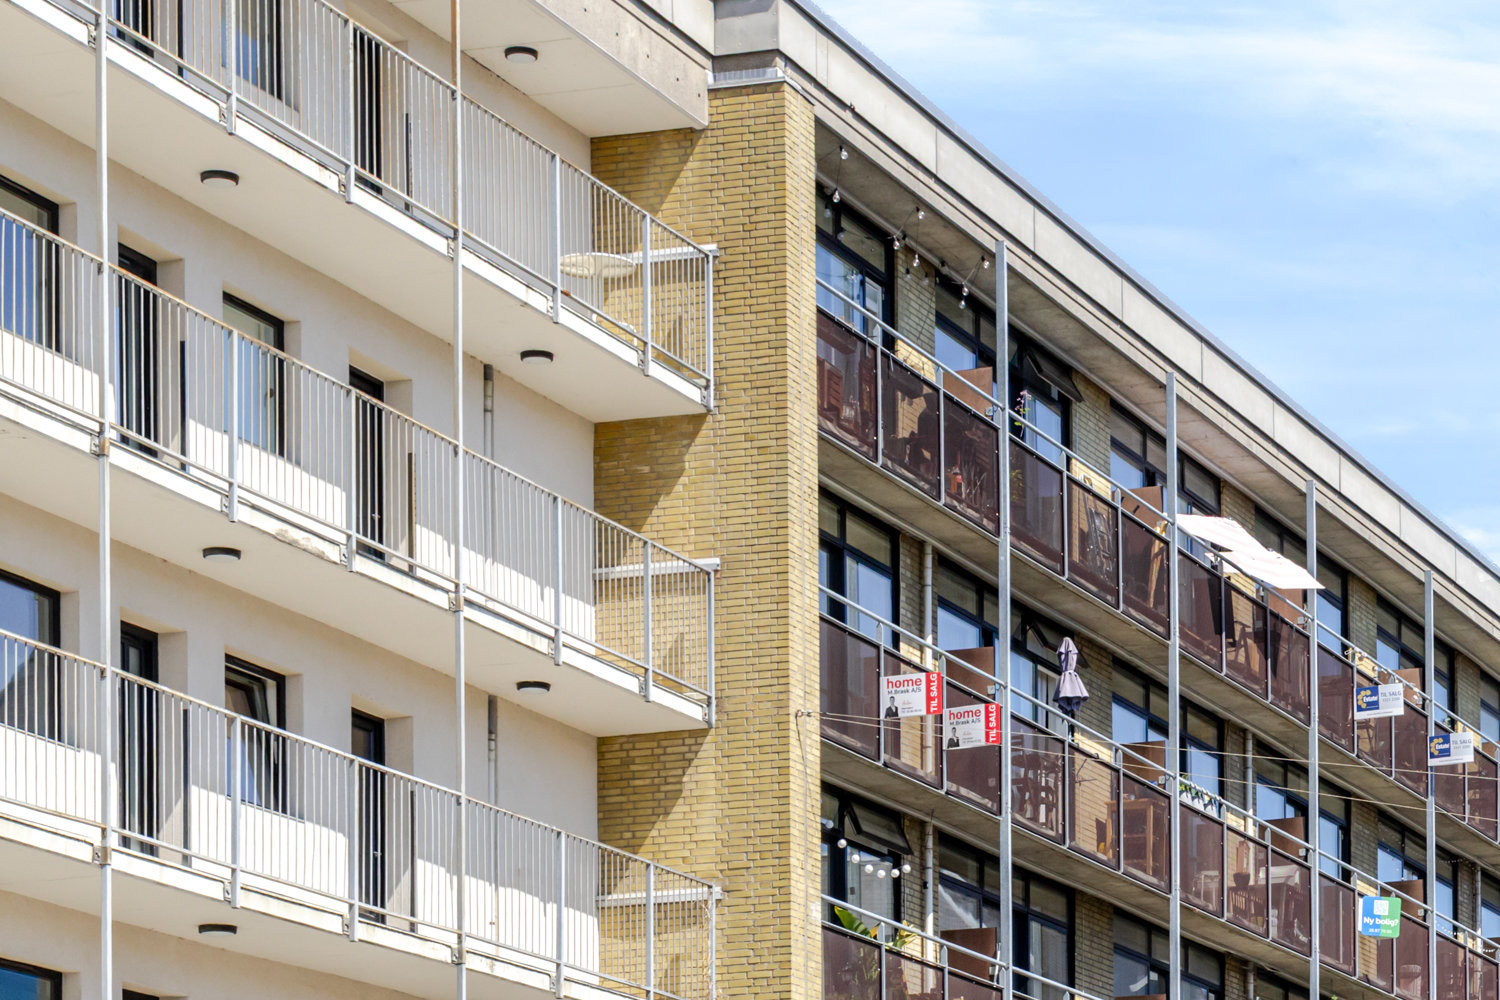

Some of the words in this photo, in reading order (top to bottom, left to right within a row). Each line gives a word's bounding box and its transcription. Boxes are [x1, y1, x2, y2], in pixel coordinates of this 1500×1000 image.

[886, 677, 922, 689] home
[929, 673, 938, 697] SALG
[930, 696, 938, 713] TIL
[948, 708, 982, 721] home
[988, 704, 997, 728] SALG
[989, 726, 997, 742] TIL
[1363, 917, 1375, 925] Ny
